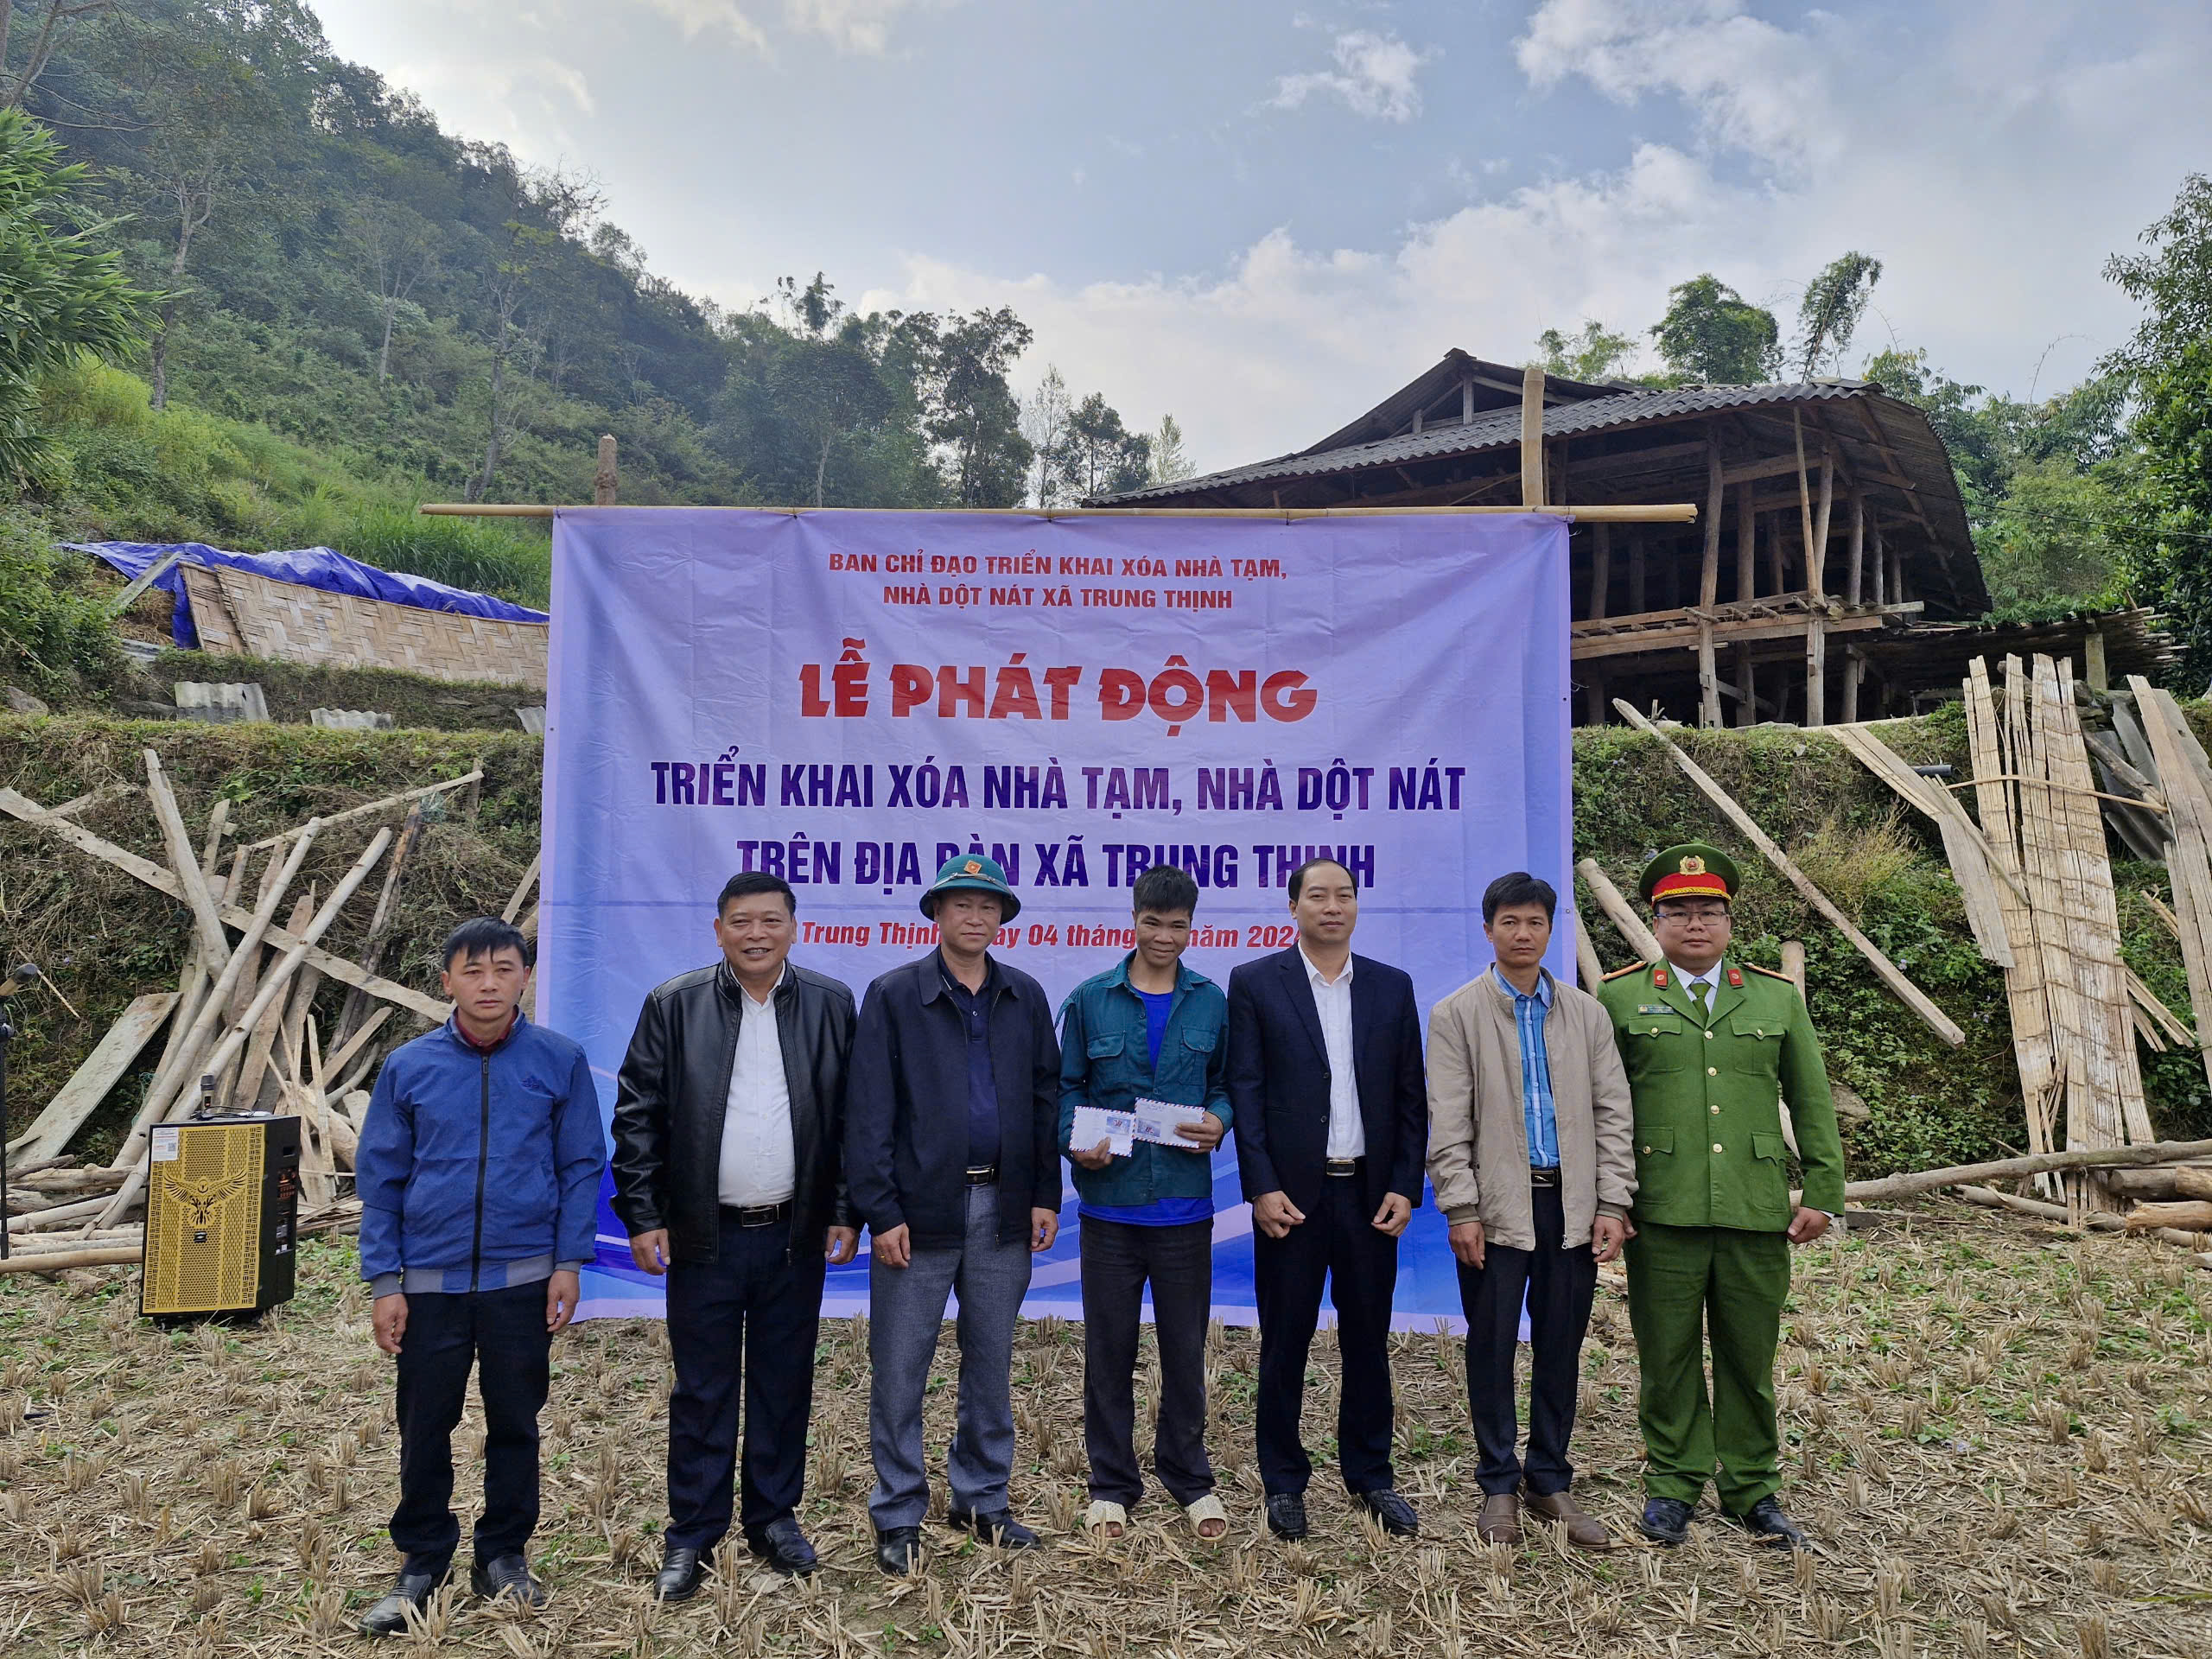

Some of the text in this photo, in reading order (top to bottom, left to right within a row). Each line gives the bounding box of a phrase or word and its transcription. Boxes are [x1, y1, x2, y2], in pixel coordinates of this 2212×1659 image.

[830, 549, 1287, 582] BAN CHỈ ĐẠO TRIỂN KHAI XÓA NHÀ TẠM,
[883, 583, 1232, 613] NHÀ DỘT NÁT XÃ TRUNG THỊNH
[798, 638, 1319, 737] LỄ PHÁT ĐỘNG
[651, 745, 1466, 821] TRIỂN KHAI XÓA NHÀ TẠM, NHÀ DỘT NÁT
[736, 832, 842, 884] TRÊN
[854, 842, 923, 895] ĐỊA
[1033, 835, 1090, 887] XÃ
[802, 922, 871, 947] Trung
[1028, 924, 1058, 947] 04
[1066, 924, 1137, 950] tháng
[1186, 925, 1239, 948] năm
[1247, 925, 1301, 948] 202
